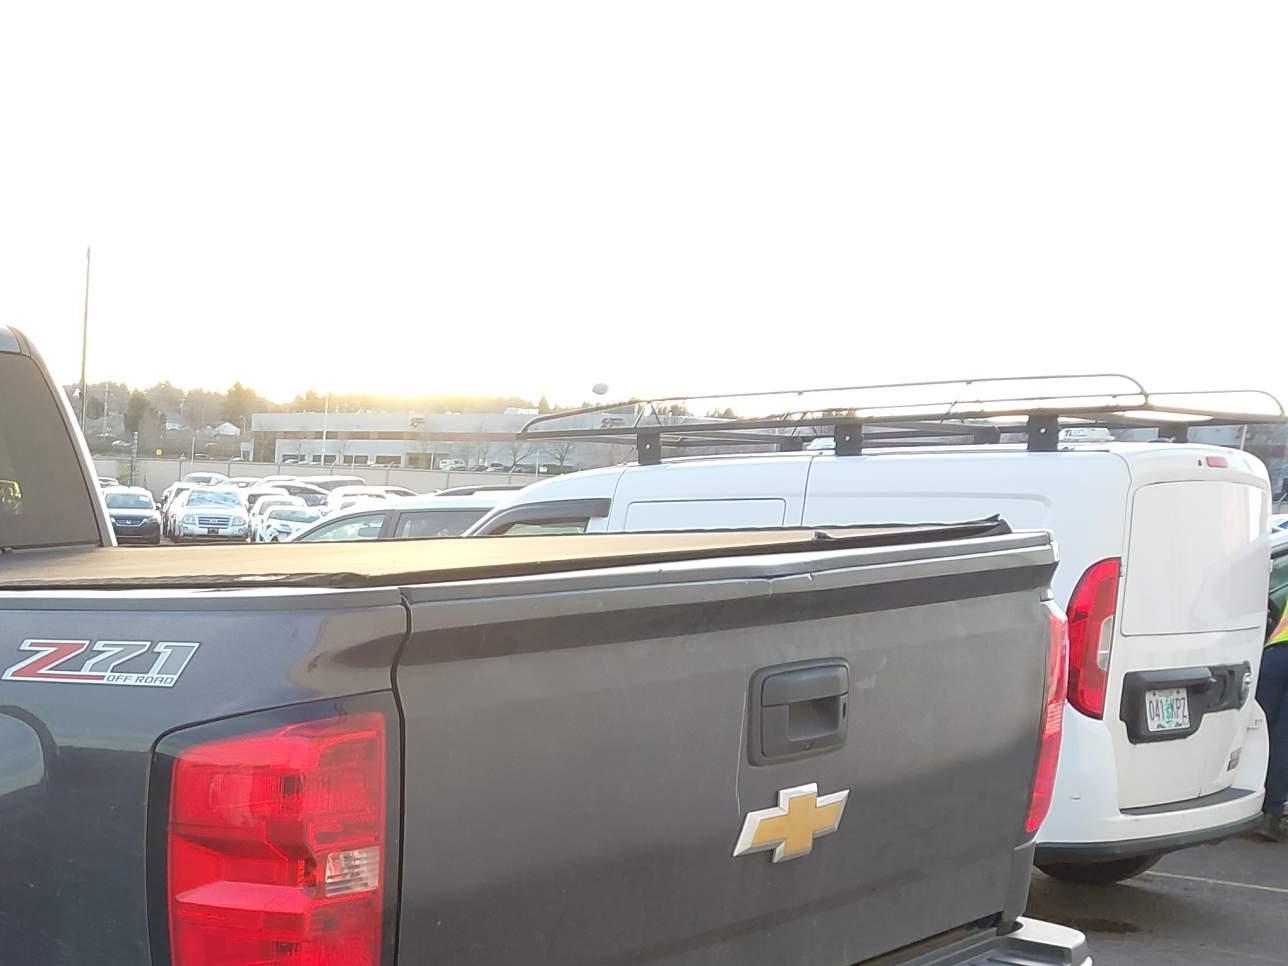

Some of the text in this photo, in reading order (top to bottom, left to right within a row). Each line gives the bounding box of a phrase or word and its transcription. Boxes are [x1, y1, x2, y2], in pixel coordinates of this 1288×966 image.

[1, 639, 201, 684] Z71
[106, 675, 174, 685] OFF ROAD
